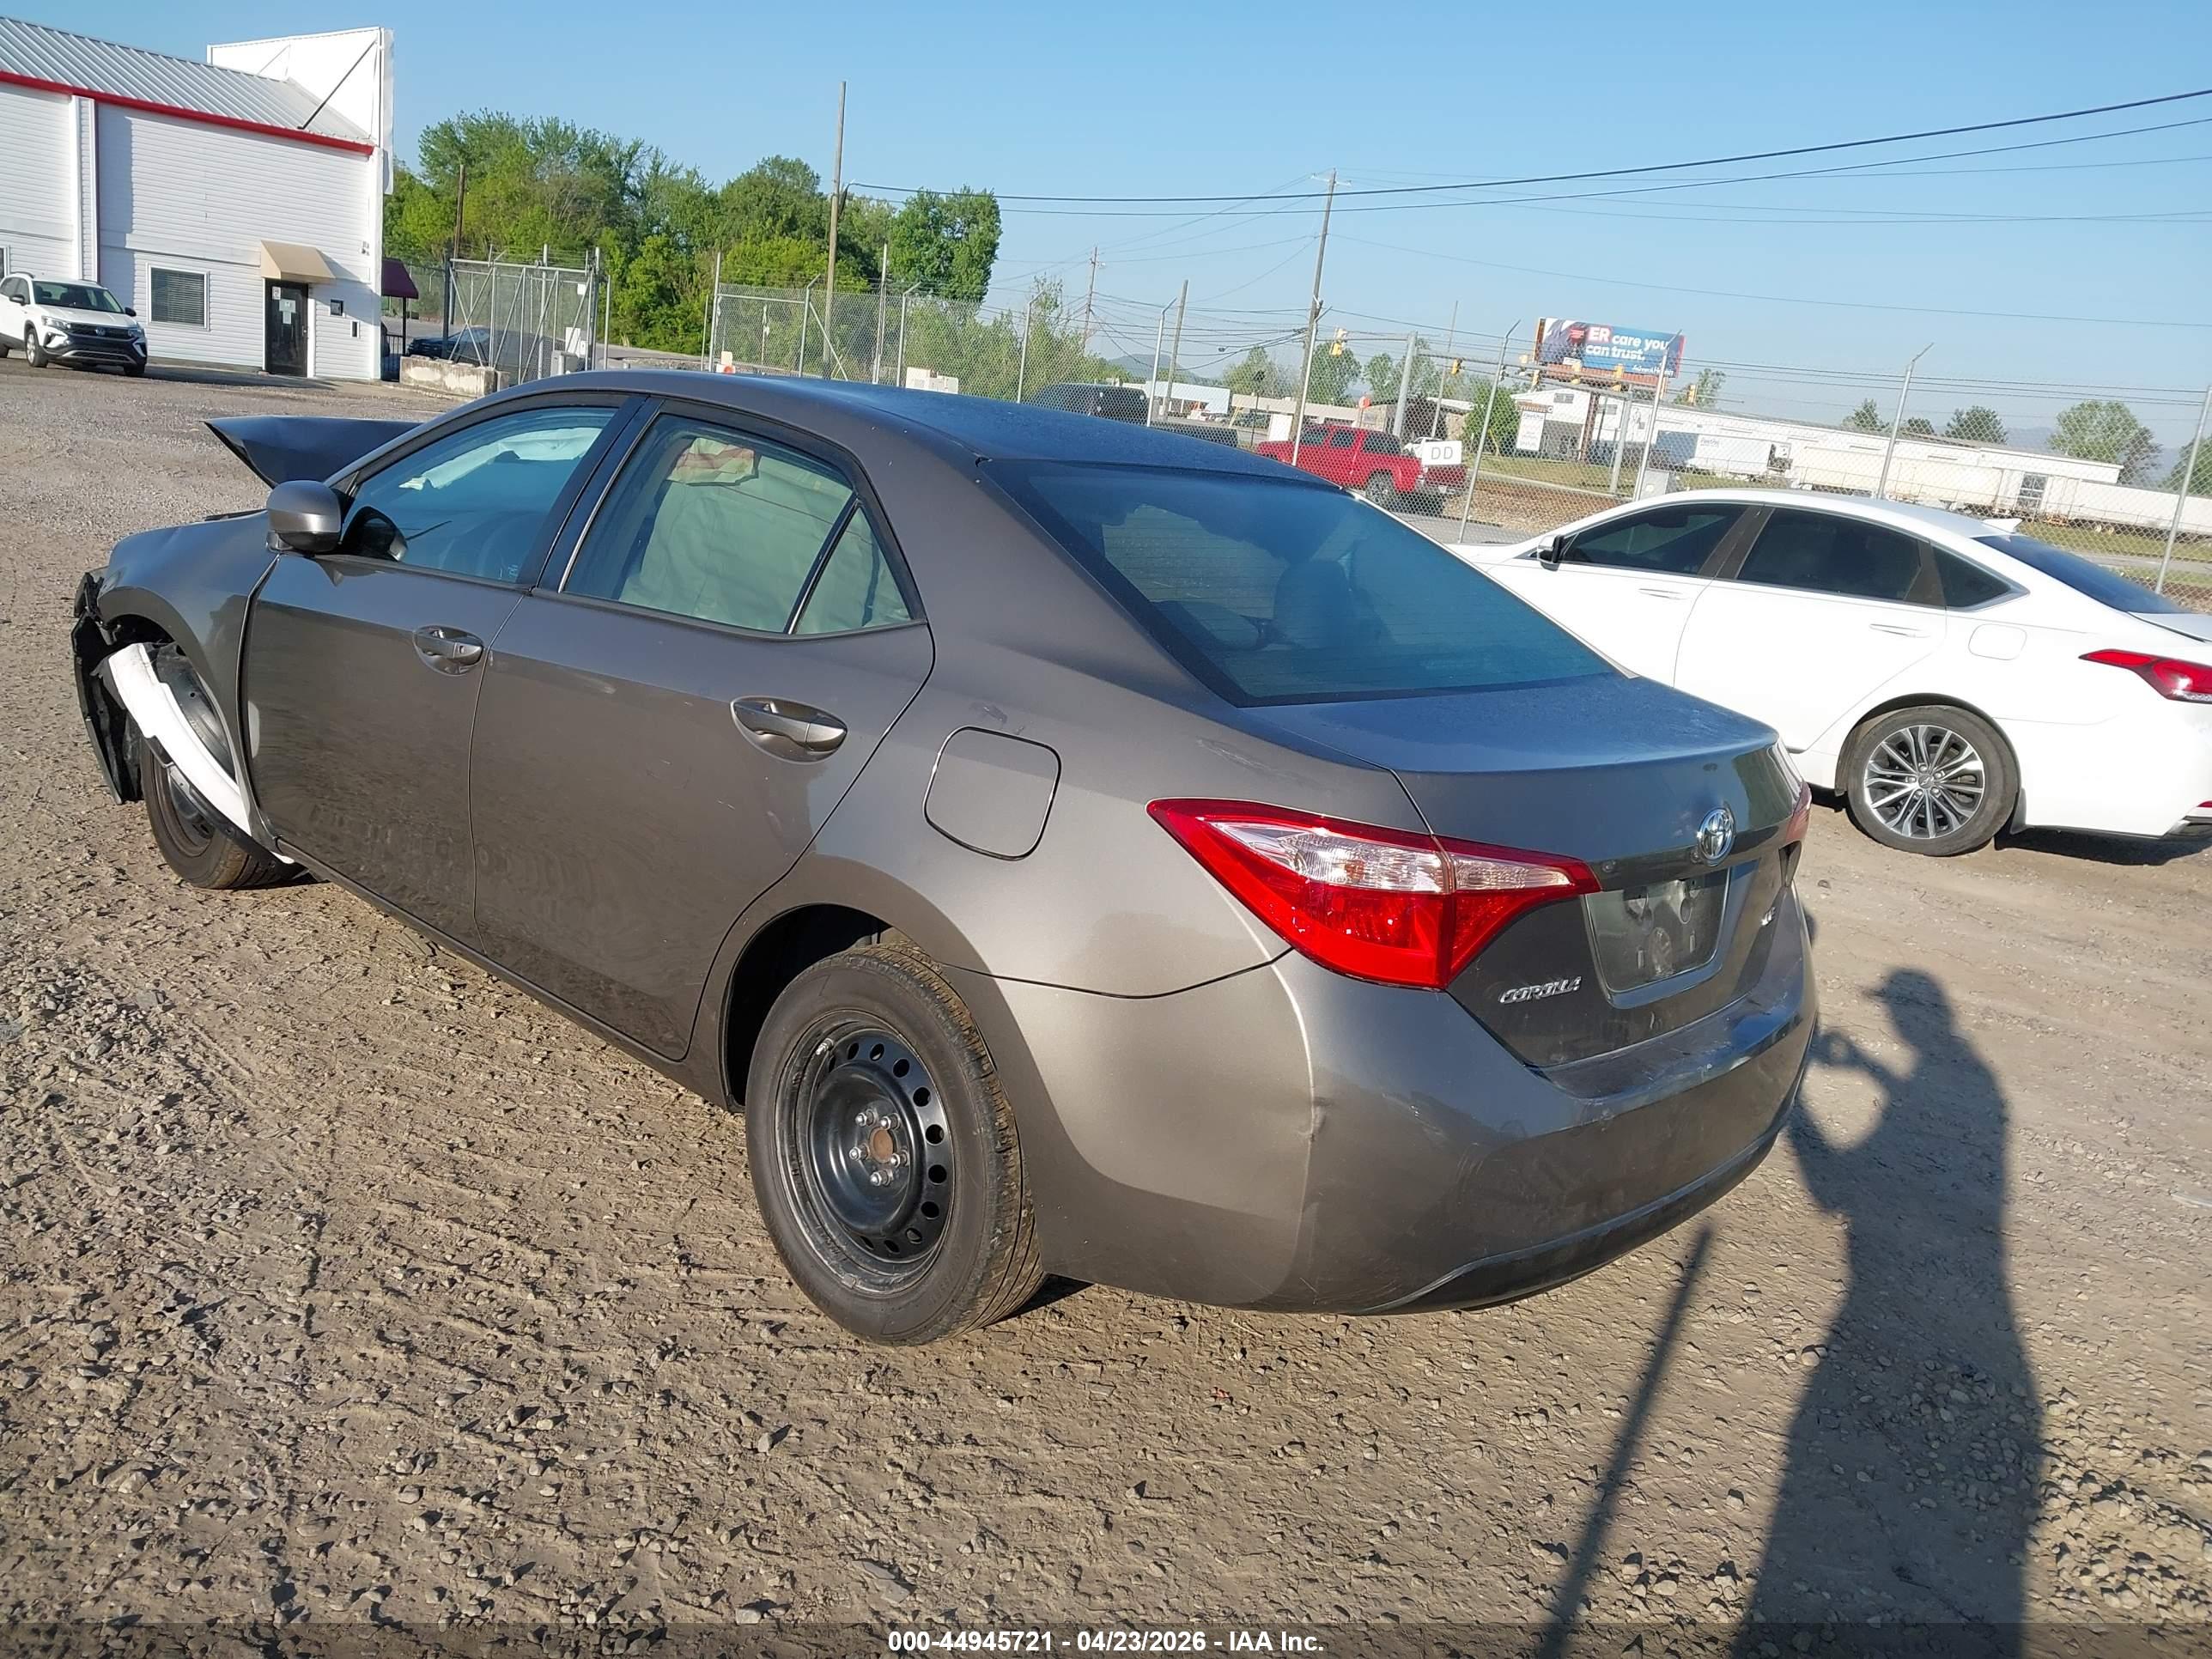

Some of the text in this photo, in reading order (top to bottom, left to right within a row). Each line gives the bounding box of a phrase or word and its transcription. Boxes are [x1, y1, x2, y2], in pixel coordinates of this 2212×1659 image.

[1588, 326, 1669, 351] ER care you
[1585, 344, 1646, 361] can trust.
[1499, 975, 1583, 1005] COROLLA
